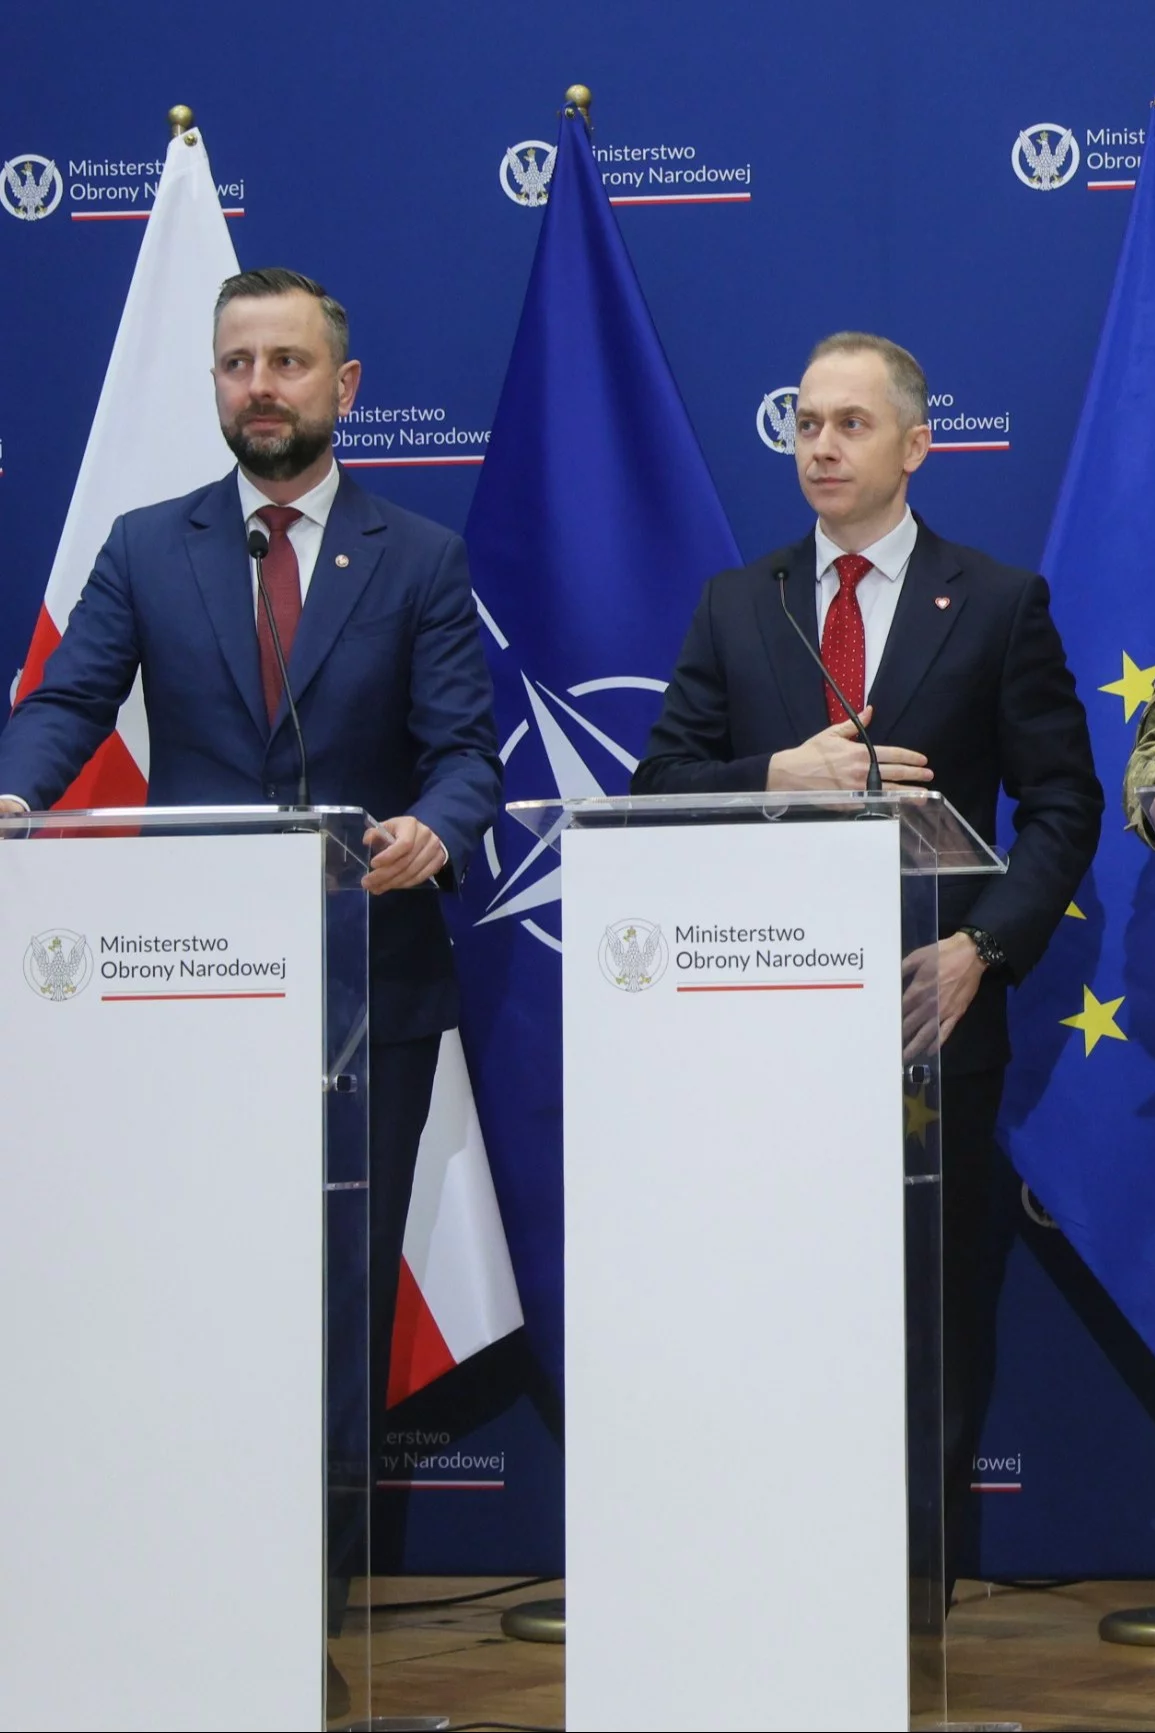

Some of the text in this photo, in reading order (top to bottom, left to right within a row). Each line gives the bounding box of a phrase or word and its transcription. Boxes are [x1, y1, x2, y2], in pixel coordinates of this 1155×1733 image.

[591, 144, 695, 162] inisterstwo
[1086, 152, 1142, 170] Obro
[69, 159, 166, 177] Ministerst
[601, 164, 751, 188] rony Narodowej
[69, 183, 140, 202] Obrony
[338, 405, 446, 424] nisterstwo
[399, 426, 492, 446] Narodowe
[675, 924, 805, 944] Ministerstwo
[100, 935, 229, 954] Ministerstwo
[100, 957, 287, 982] Obrony Narodowej
[676, 947, 864, 973] Obrony Narodowej
[403, 1451, 505, 1473] Narodowej
